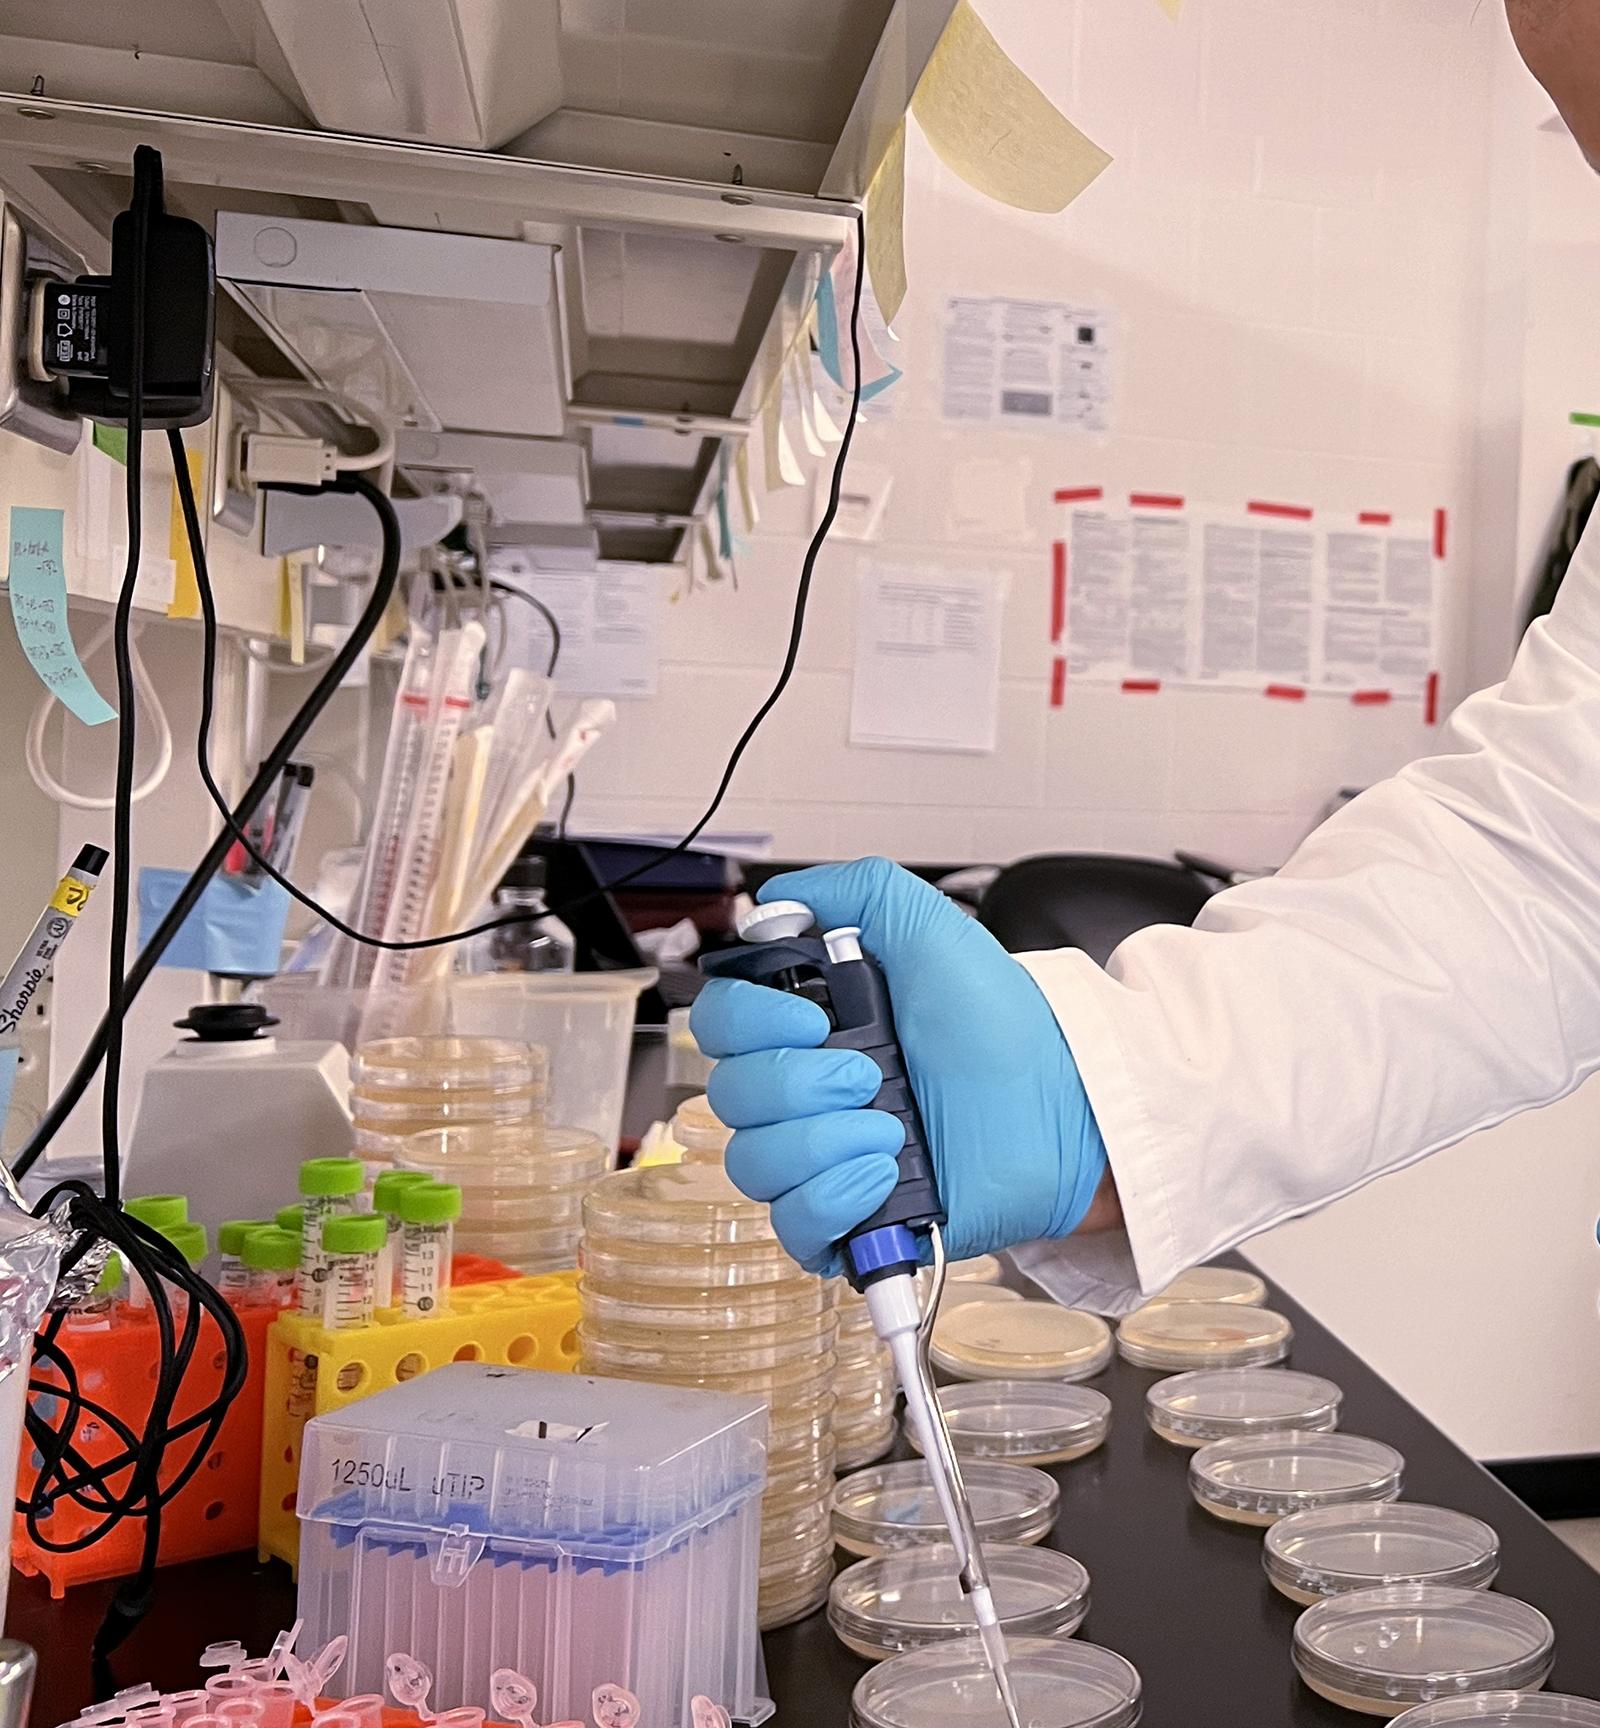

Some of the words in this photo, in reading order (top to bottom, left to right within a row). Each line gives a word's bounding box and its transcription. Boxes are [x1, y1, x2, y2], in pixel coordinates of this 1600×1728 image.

[0, 967, 46, 1033] Sharpie
[422, 1250, 435, 1260] 13
[421, 1266, 434, 1277] 12
